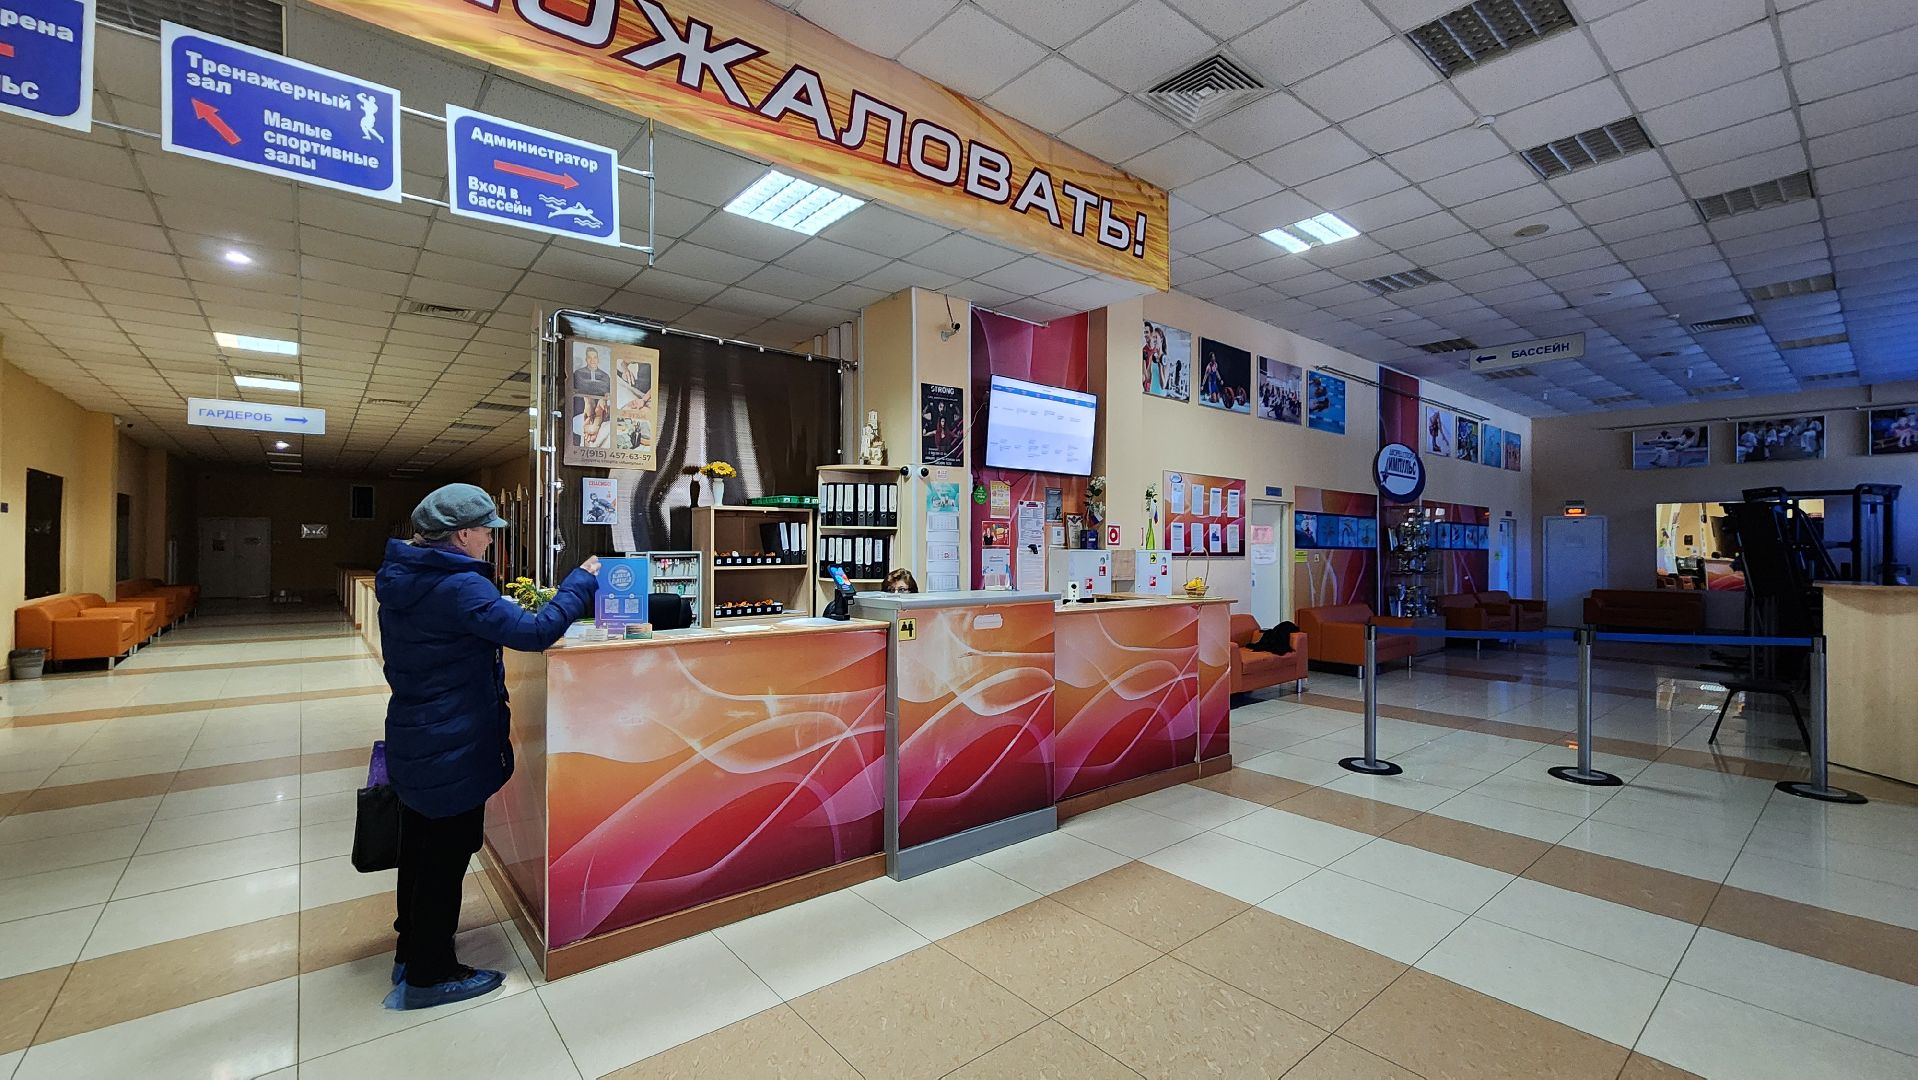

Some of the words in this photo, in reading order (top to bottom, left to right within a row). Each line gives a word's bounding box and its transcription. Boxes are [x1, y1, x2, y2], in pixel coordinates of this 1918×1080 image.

[0, 74, 40, 100] ьс
[186, 49, 352, 111] Тренажерный
[187, 71, 232, 95] зал
[264, 108, 333, 141] Малые
[264, 130, 380, 169] спортивные
[264, 148, 318, 171] залы
[470, 126, 600, 174] Администратор
[468, 176, 507, 200] Вход
[510, 187, 519, 199] в
[468, 191, 533, 217] бассейн
[1511, 342, 1570, 359] БАССЕЙН
[930, 385, 955, 395] STRONG
[198, 408, 273, 422] ГАРДЕРОБ
[609, 451, 652, 462] 457-63-57
